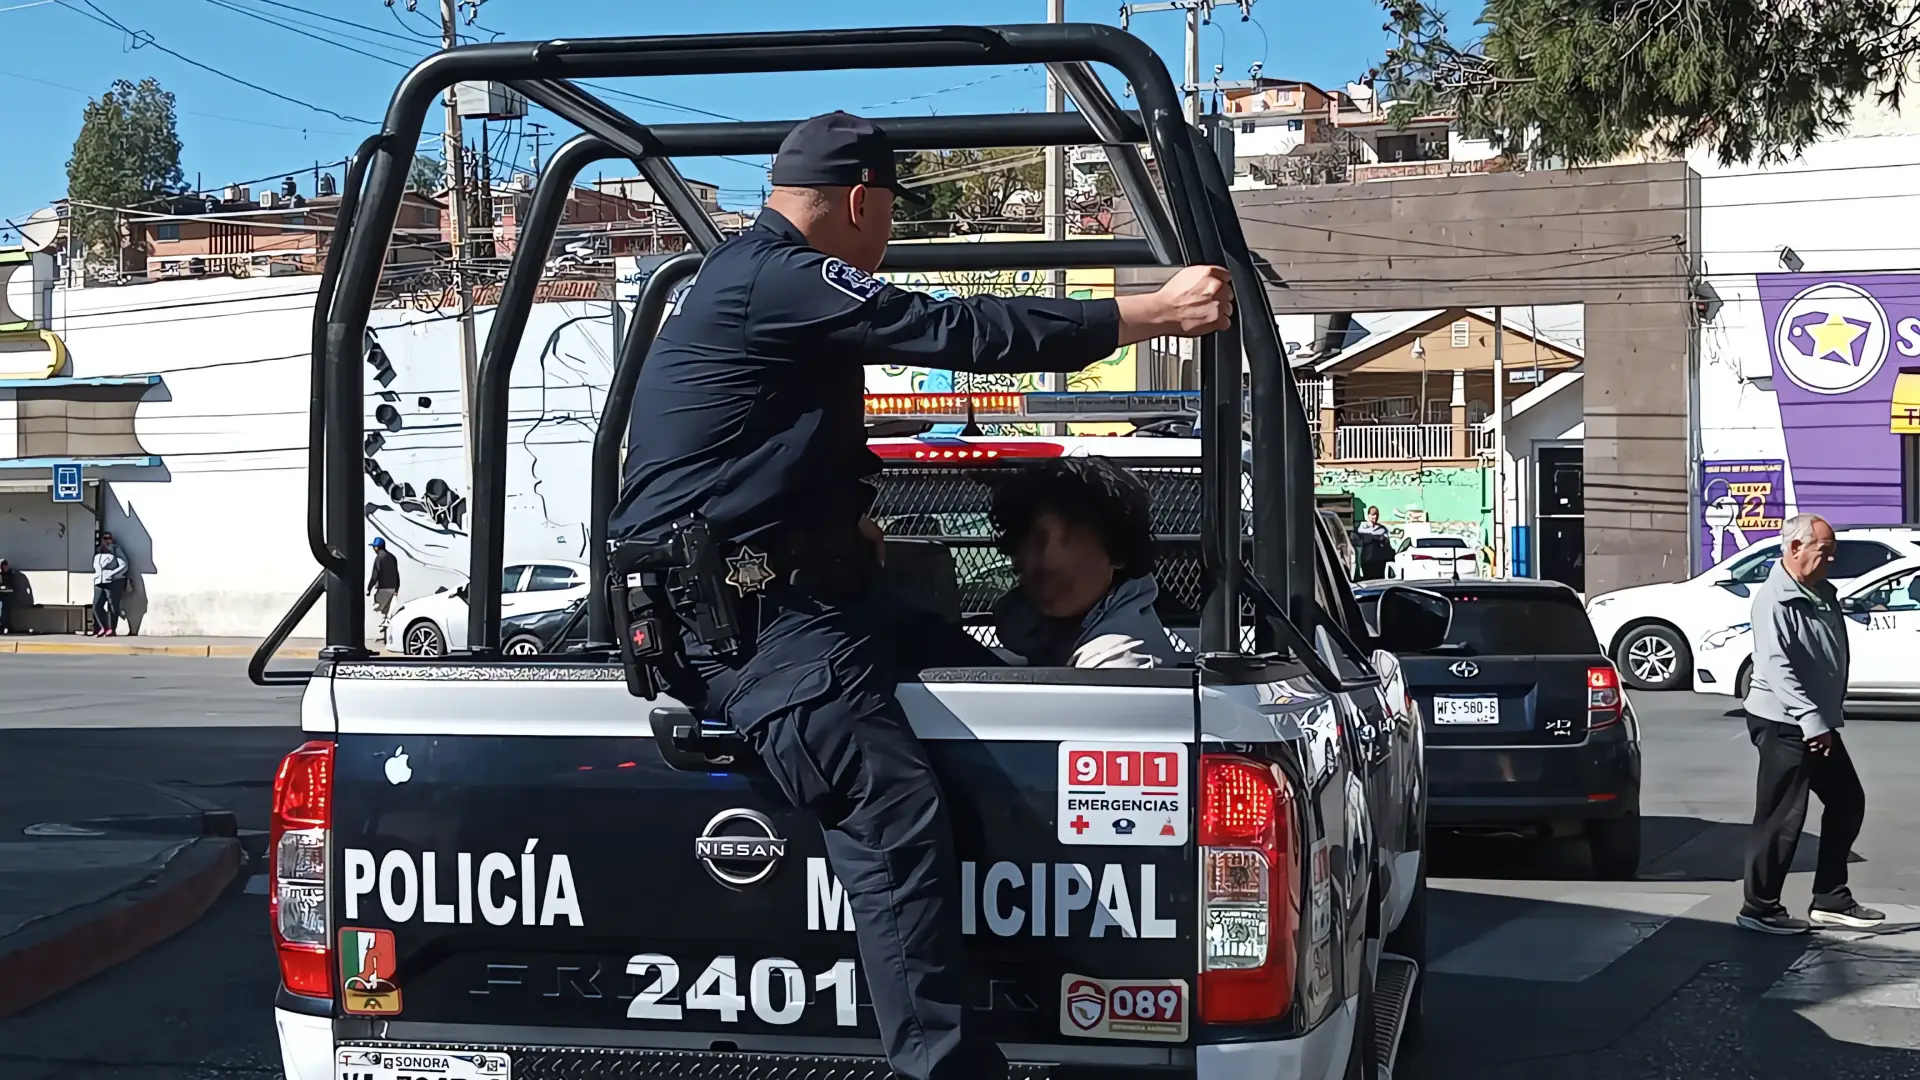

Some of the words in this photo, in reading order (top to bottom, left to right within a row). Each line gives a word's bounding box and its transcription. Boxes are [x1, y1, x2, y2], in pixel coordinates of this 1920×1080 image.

[1744, 496, 1763, 518] 2
[1075, 755, 1168, 782] 911
[1068, 799, 1179, 812] EMERGENCIAS
[697, 842, 785, 857] NISSAN
[344, 838, 585, 927] POLICÍA
[806, 857, 1177, 939] MICIPAL
[625, 953, 858, 1027] 2401
[1112, 988, 1179, 1020] 089
[395, 1056, 450, 1069] SONORA
